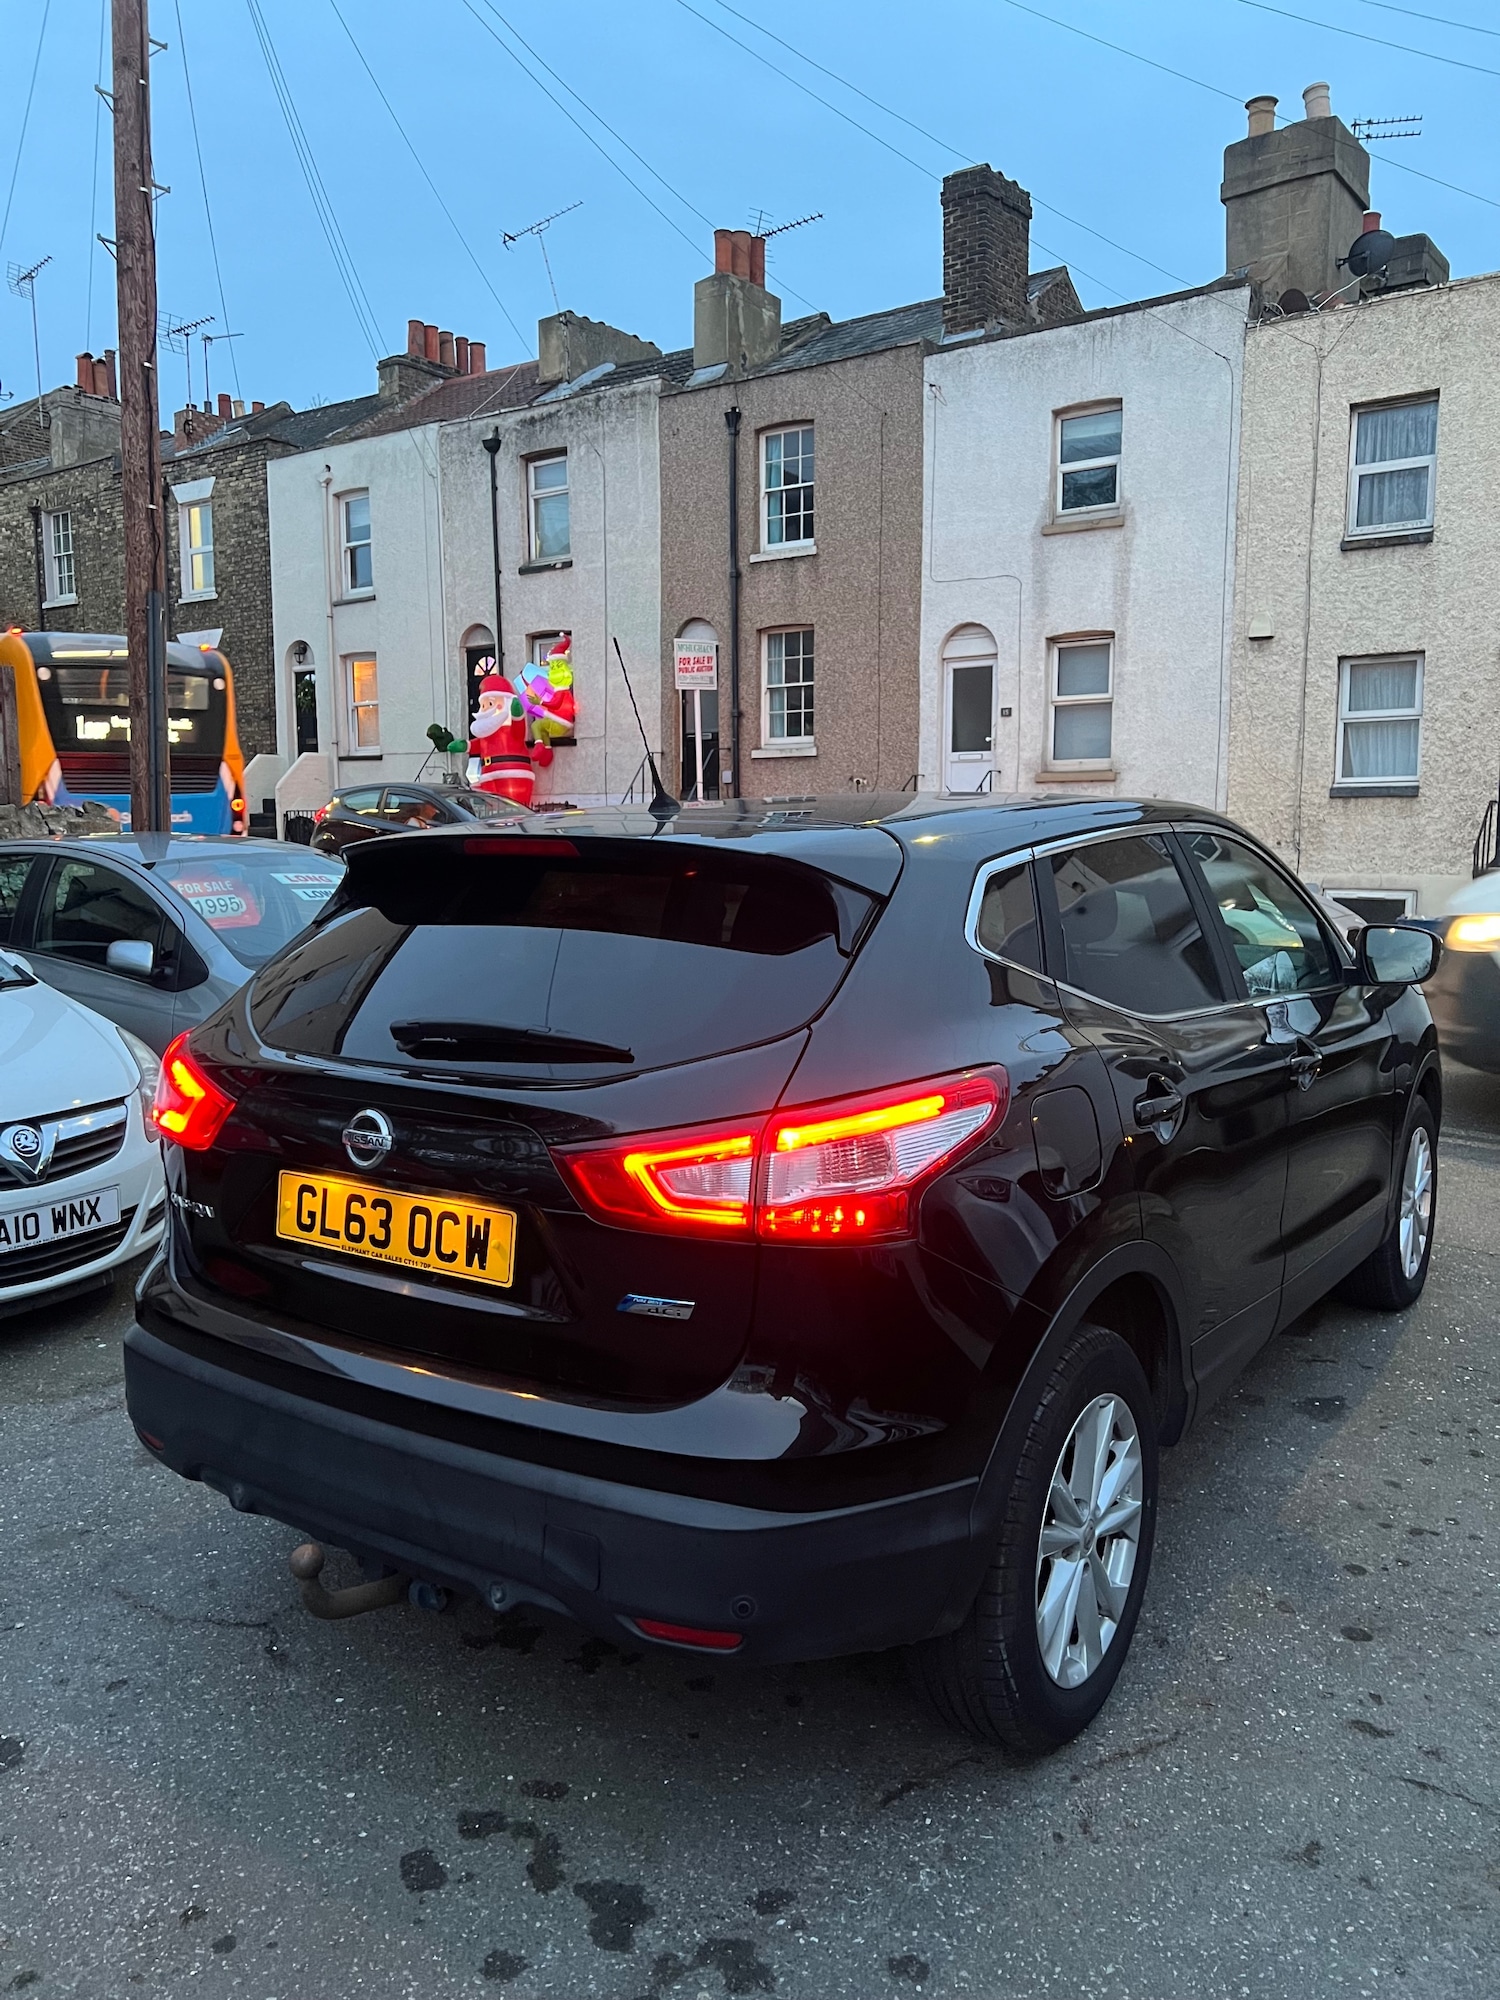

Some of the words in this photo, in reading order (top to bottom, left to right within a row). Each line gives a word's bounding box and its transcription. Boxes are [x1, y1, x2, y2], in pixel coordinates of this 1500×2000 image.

[678, 657, 691, 666] FOR
[693, 656, 705, 665] SALE
[707, 656, 713, 664] BY
[177, 882, 203, 895] FOR
[203, 880, 235, 892] SALE
[283, 874, 334, 883] LONG
[51, 1196, 102, 1235] WNX
[296, 1183, 393, 1250] GL63
[407, 1205, 492, 1271] OCW
[341, 1244, 370, 1257] ELEPHANT
[371, 1251, 383, 1259] CAR
[384, 1254, 402, 1264] SALES
[403, 1258, 419, 1267] CT11
